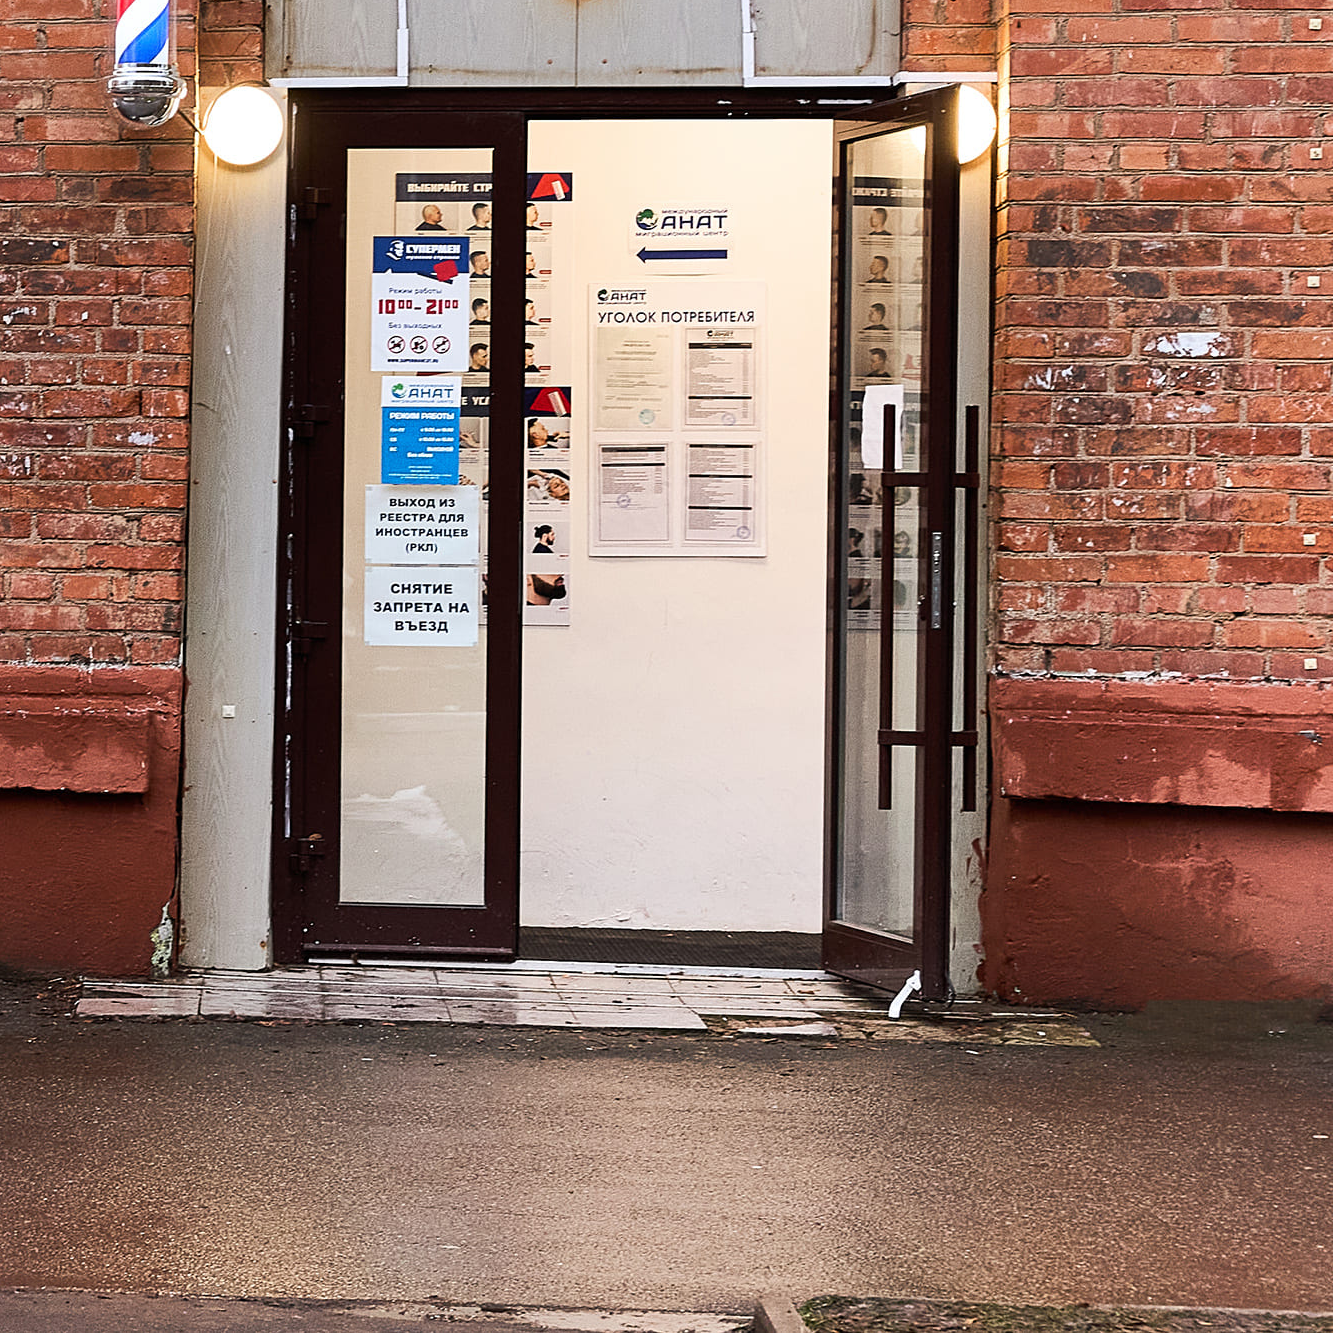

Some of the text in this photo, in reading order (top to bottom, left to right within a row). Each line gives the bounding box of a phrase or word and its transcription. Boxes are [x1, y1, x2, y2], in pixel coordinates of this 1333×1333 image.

[407, 180, 493, 193] ВЫБИРАЙТЕ СТР
[406, 244, 461, 254] СУПЕРМЕН
[414, 287, 442, 295] работы
[598, 311, 755, 323] УГОЛОК ПОТРЕБИТЕЛЯ
[389, 412, 455, 420] РЕЖИМ РАБОТЫ
[389, 499, 456, 508] ВЫХОД ИЗ
[380, 513, 464, 523] РЕЕСТРА ДЛЯ
[375, 528, 468, 538] ИНОСТРАНЦЕВ
[405, 543, 438, 554] (РКЛ)
[390, 583, 453, 594] СНЯТИЕ
[373, 602, 470, 613] ЗАПРЕТА НА
[395, 621, 448, 633] ВЪЕЗД
